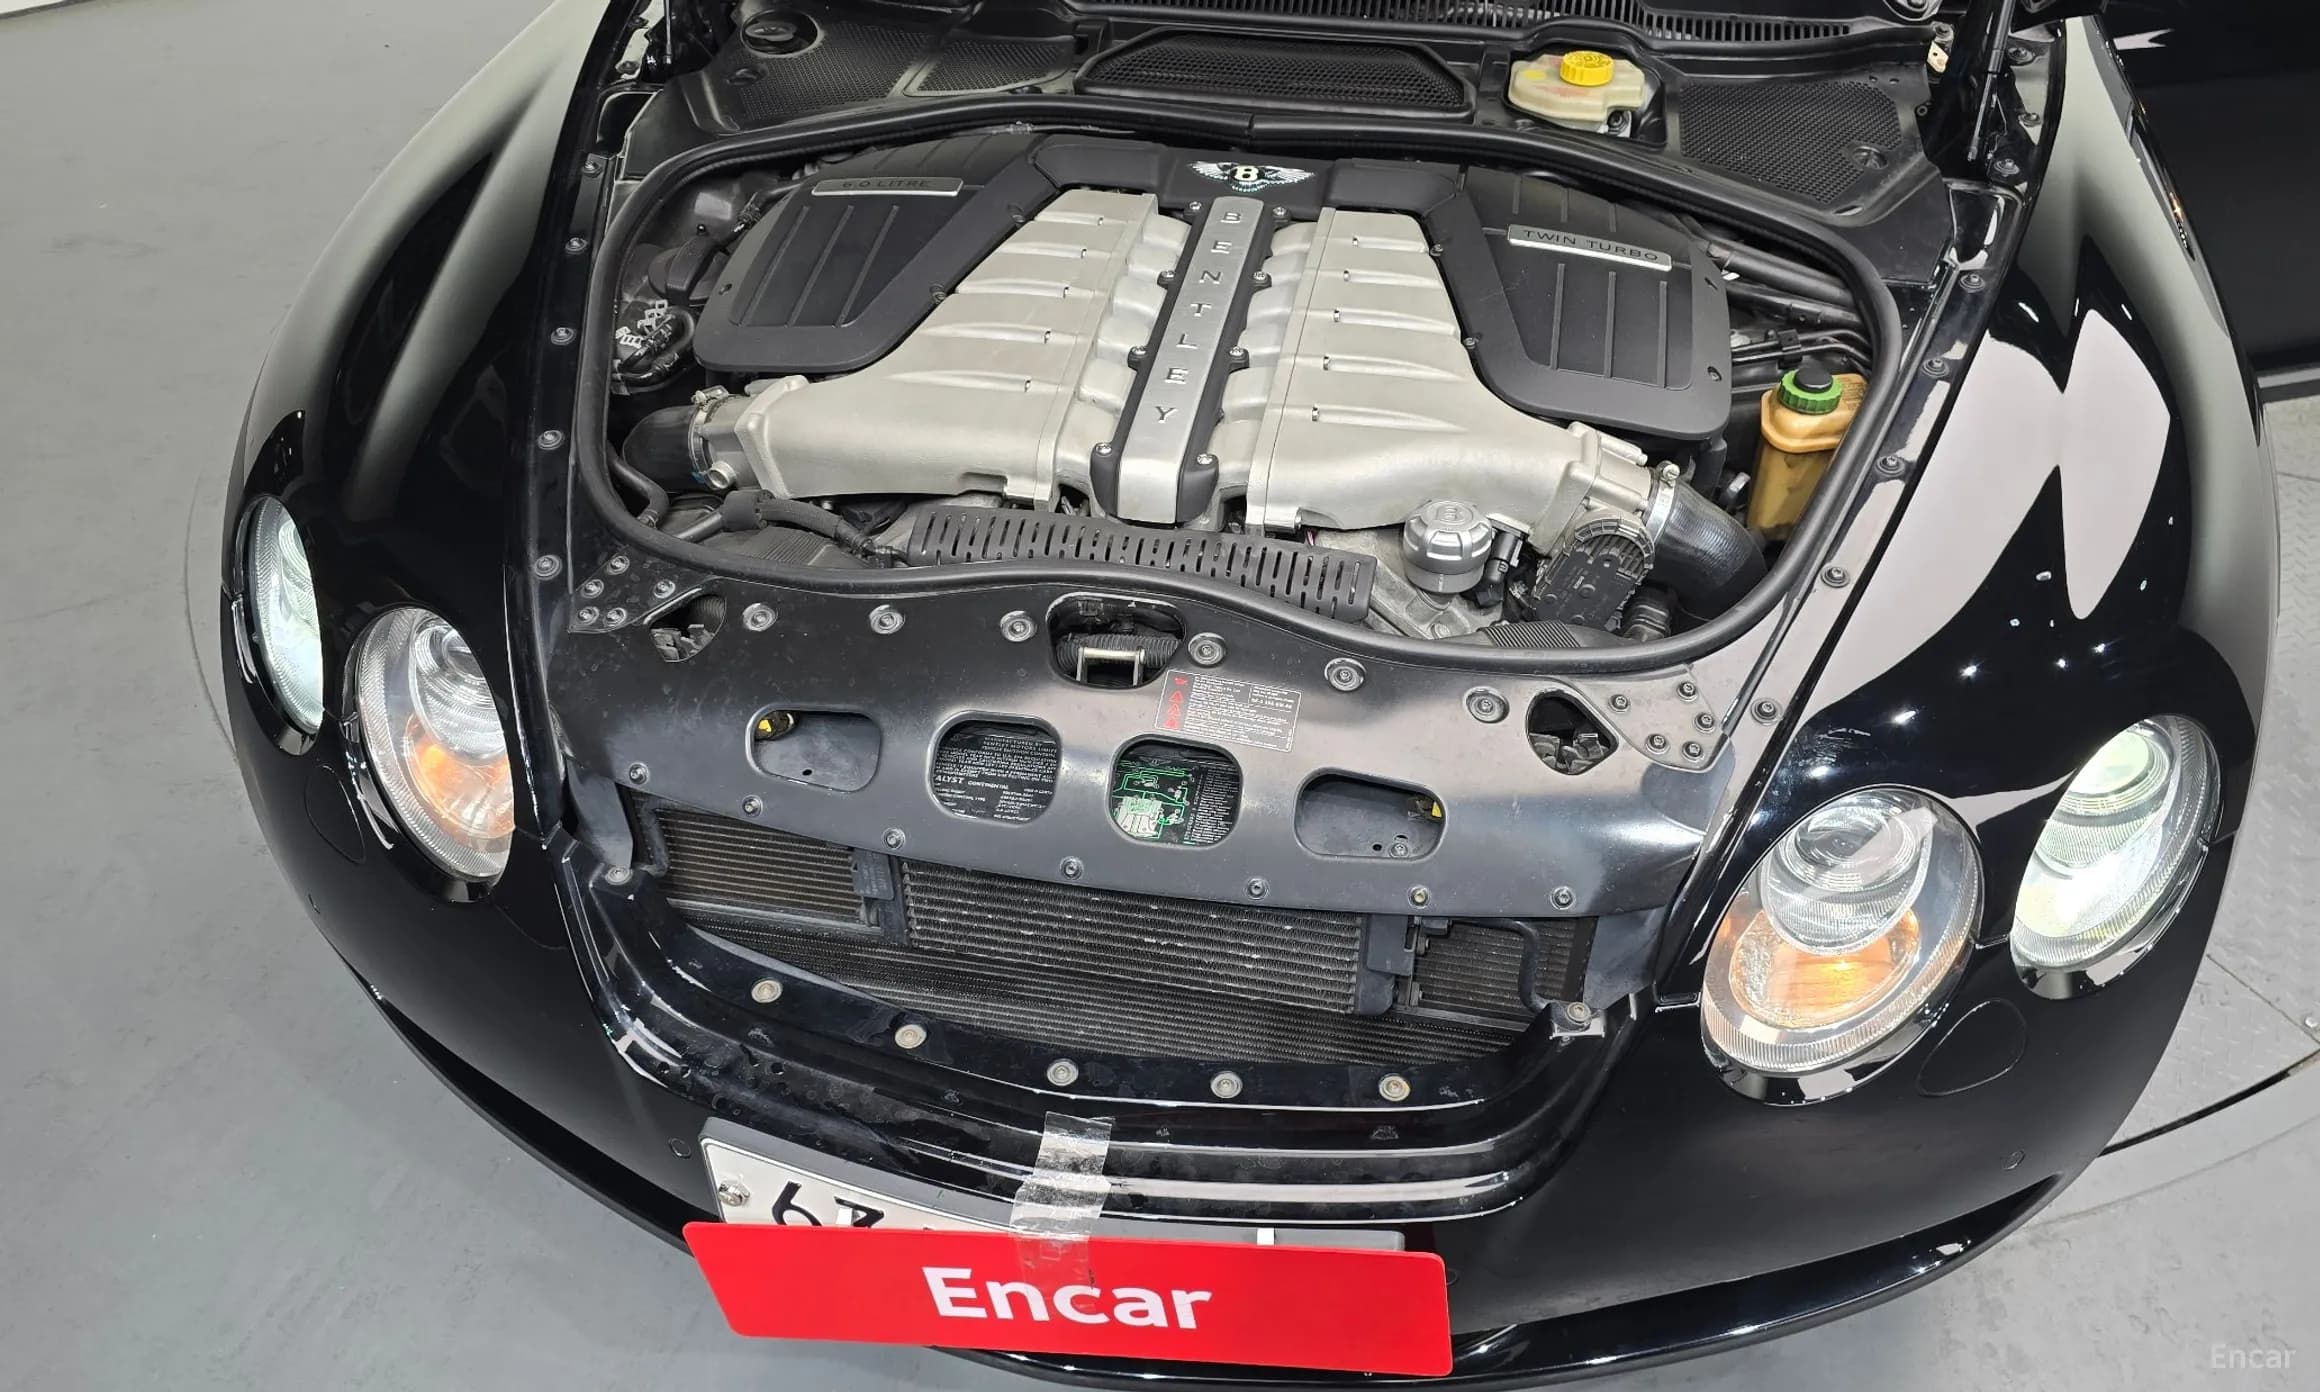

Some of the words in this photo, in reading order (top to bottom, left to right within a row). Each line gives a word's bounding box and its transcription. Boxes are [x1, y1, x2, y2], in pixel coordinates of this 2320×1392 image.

[1523, 229, 1576, 245] TWIN
[1586, 239, 1658, 261] TURBO
[1153, 210, 1243, 424] BENTLEY
[922, 1266, 1213, 1330] Encar
